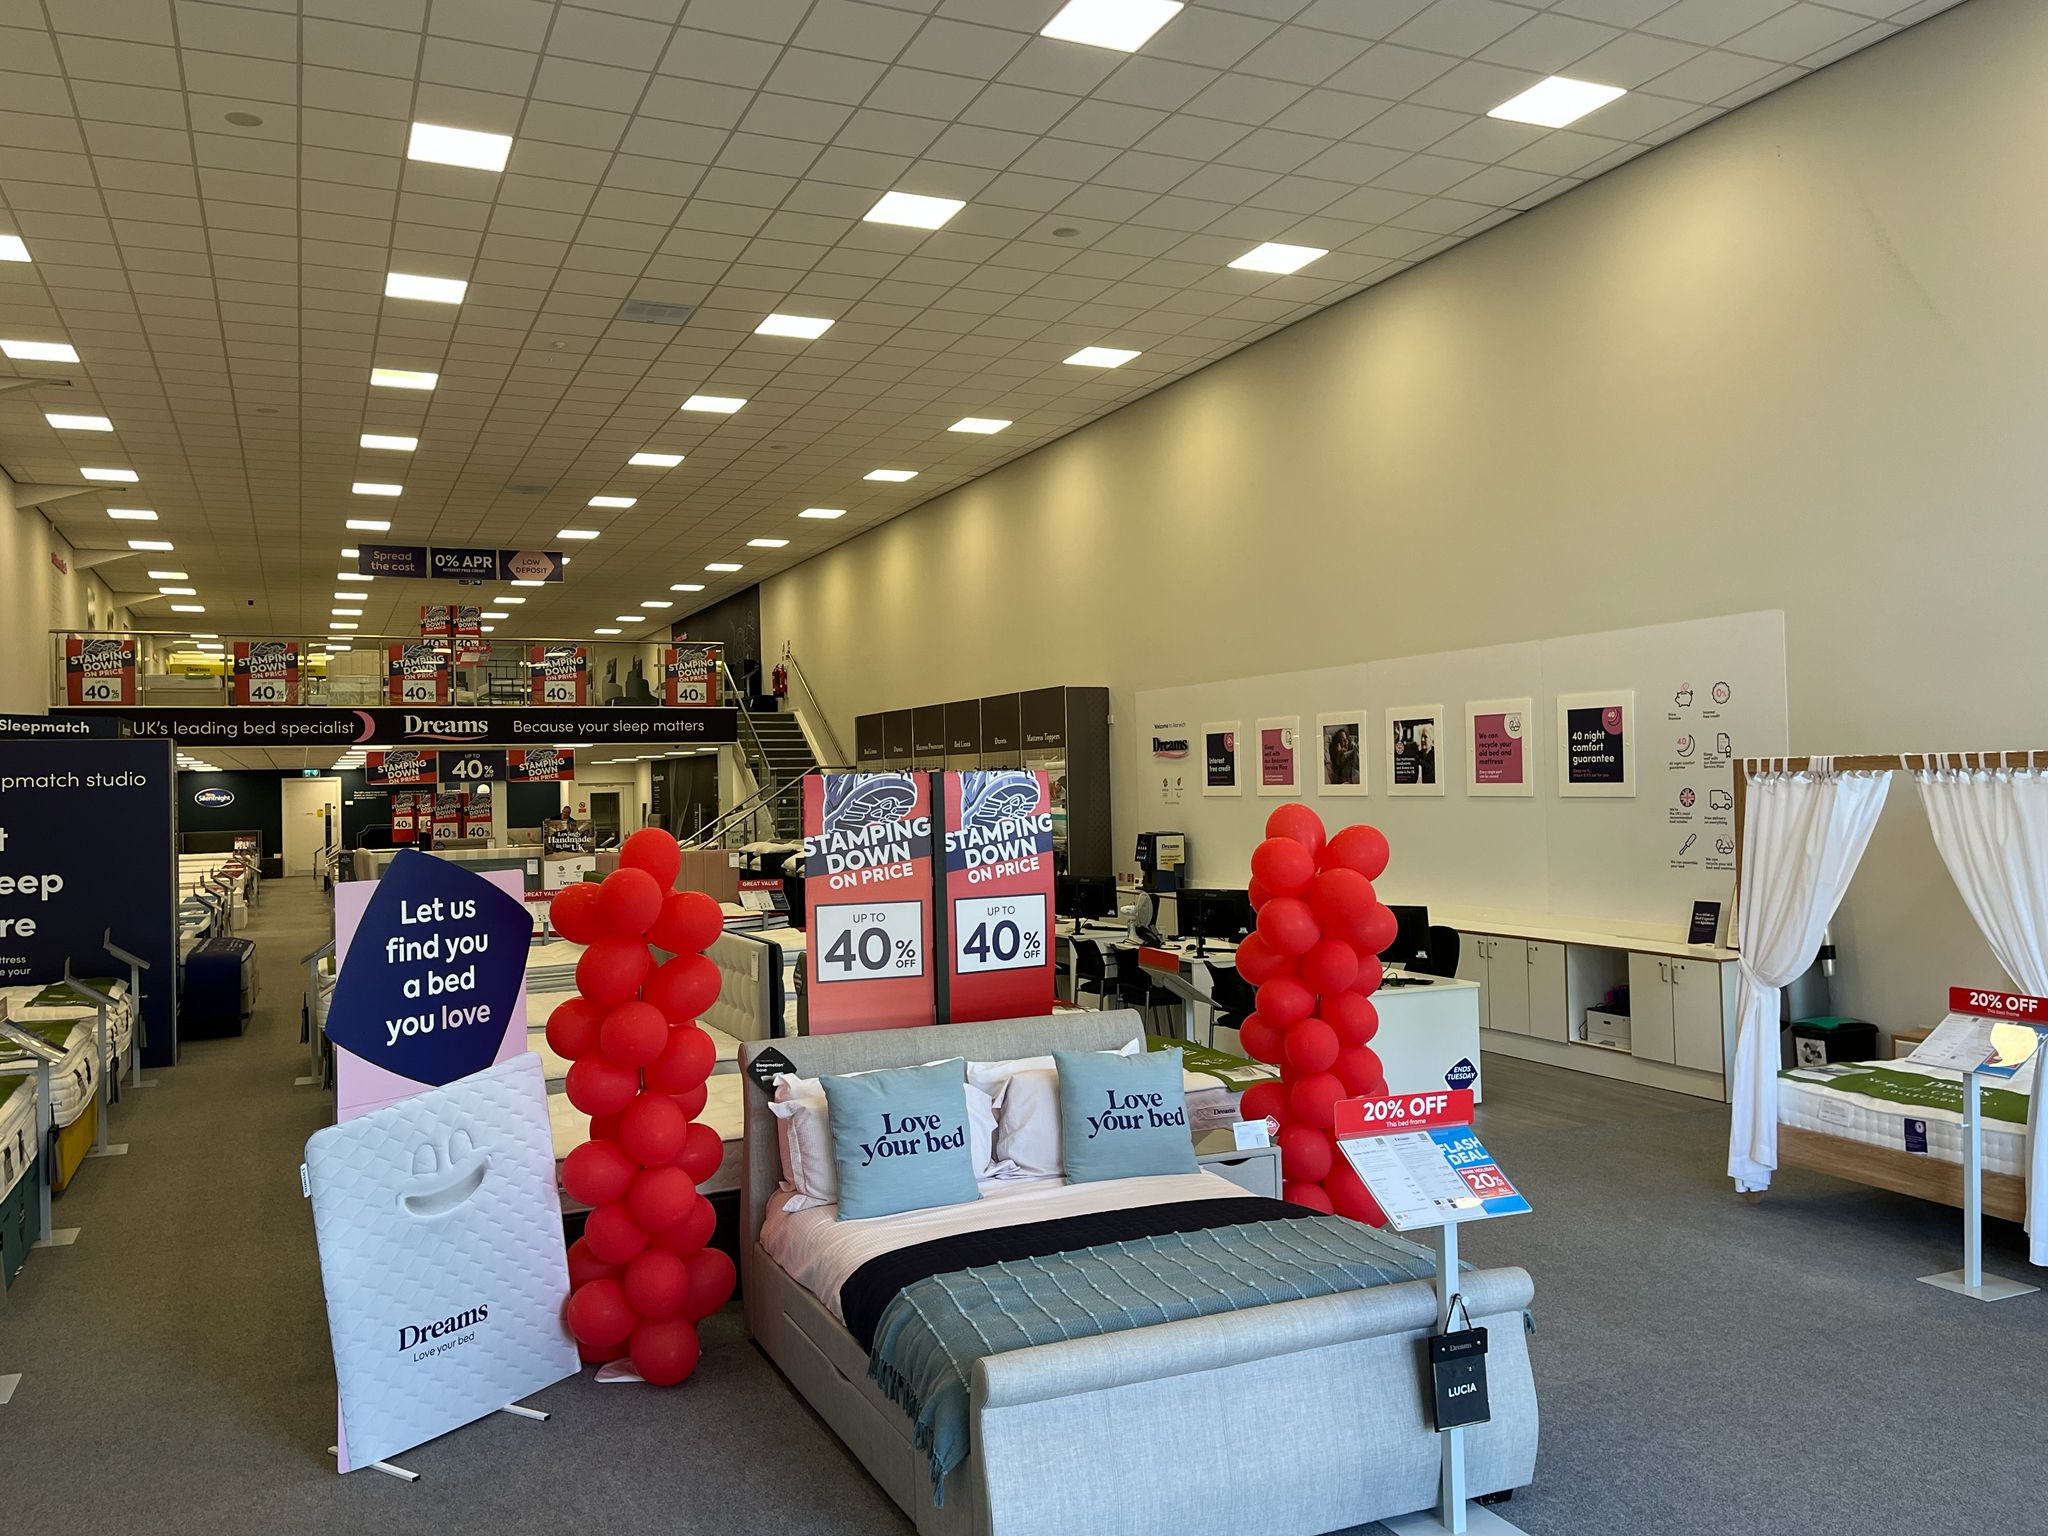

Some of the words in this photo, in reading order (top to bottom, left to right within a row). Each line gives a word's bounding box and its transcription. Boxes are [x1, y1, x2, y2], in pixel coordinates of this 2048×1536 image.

[373, 550, 412, 563] Spread
[435, 554, 460, 568] 0%
[463, 556, 492, 568] APR
[371, 560, 390, 571] the
[392, 562, 415, 572] cost
[516, 566, 548, 574] DEPOSIT
[70, 650, 132, 664] STAMPING
[238, 652, 295, 666] STAMPING
[82, 660, 122, 672] DOWN
[250, 662, 286, 674] DOWN
[545, 665, 576, 676] DOWN
[668, 659, 714, 672] STAMPING
[84, 670, 97, 678] ON
[98, 668, 124, 676] PRICE
[264, 670, 288, 678] PRICE
[678, 667, 707, 678] DOWN
[0, 719, 90, 735] Sleepmatch
[133, 721, 168, 736] UK's
[174, 720, 238, 738] leading
[244, 720, 276, 735] bed
[281, 720, 354, 738] specialist
[404, 714, 488, 734] Dreams
[513, 720, 574, 733] Because
[578, 723, 614, 736] your
[617, 720, 650, 734] sleep
[653, 719, 705, 732] matters
[1572, 731, 1582, 740] 40
[1584, 730, 1605, 742] night
[1152, 737, 1188, 752] Dreams
[1479, 741, 1498, 749] recycle
[1572, 742, 1604, 752] comfort
[518, 758, 566, 771] STAMPING
[1572, 754, 1615, 766] guarantee
[378, 760, 427, 774] STAMPING
[388, 768, 420, 779] DOWN
[528, 766, 558, 776] DOWN
[1209, 764, 1218, 772] free
[2, 772, 80, 792] pmatch
[86, 770, 147, 788] studio
[436, 808, 456, 816] DOWN
[469, 808, 490, 816] DOWN
[804, 816, 931, 858] STAMPING
[944, 812, 1052, 853] STAMPING
[548, 836, 592, 844] Handmade
[572, 844, 588, 852] UK
[964, 838, 1038, 869] DOWN
[826, 840, 911, 875] DOWN
[829, 872, 858, 890] ON
[862, 862, 914, 886] PRICE
[968, 866, 992, 884] ON
[996, 857, 1040, 879] PRICE
[400, 898, 444, 924] Let
[450, 898, 476, 920] us
[987, 906, 1000, 916] UP
[1001, 904, 1016, 915] TO
[852, 914, 868, 924] UP
[870, 912, 886, 922] TO
[386, 934, 439, 964] find
[445, 934, 488, 964] you
[1024, 948, 1041, 960] OFF
[896, 958, 916, 969] OFF
[8, 967, 32, 978] your
[403, 979, 420, 998] a
[428, 965, 476, 996] bed
[1970, 992, 2003, 1009] 20%
[2006, 997, 2038, 1013] OFF
[385, 1012, 435, 1047] you
[442, 1004, 491, 1030] love
[1448, 1072, 1476, 1080] TUESDAY
[1106, 1090, 1164, 1110] Love
[1213, 1107, 1236, 1116] Dreams
[1362, 1100, 1405, 1122] 20%
[1410, 1095, 1448, 1116] OFF
[882, 1113, 942, 1136] Love
[1086, 1108, 1146, 1139] your
[1149, 1106, 1186, 1128] bed
[1410, 1118, 1426, 1126] frame
[860, 1136, 921, 1168] your
[926, 1126, 965, 1154] bed
[1436, 1136, 1483, 1155] FLASH
[1447, 1148, 1489, 1166] DEAL
[398, 1303, 488, 1352] Dreams
[414, 1348, 436, 1362] Love
[436, 1340, 456, 1356] your
[458, 1332, 475, 1346] bed
[1450, 1342, 1472, 1352] Dreams
[1448, 1382, 1478, 1398] LUCIA
